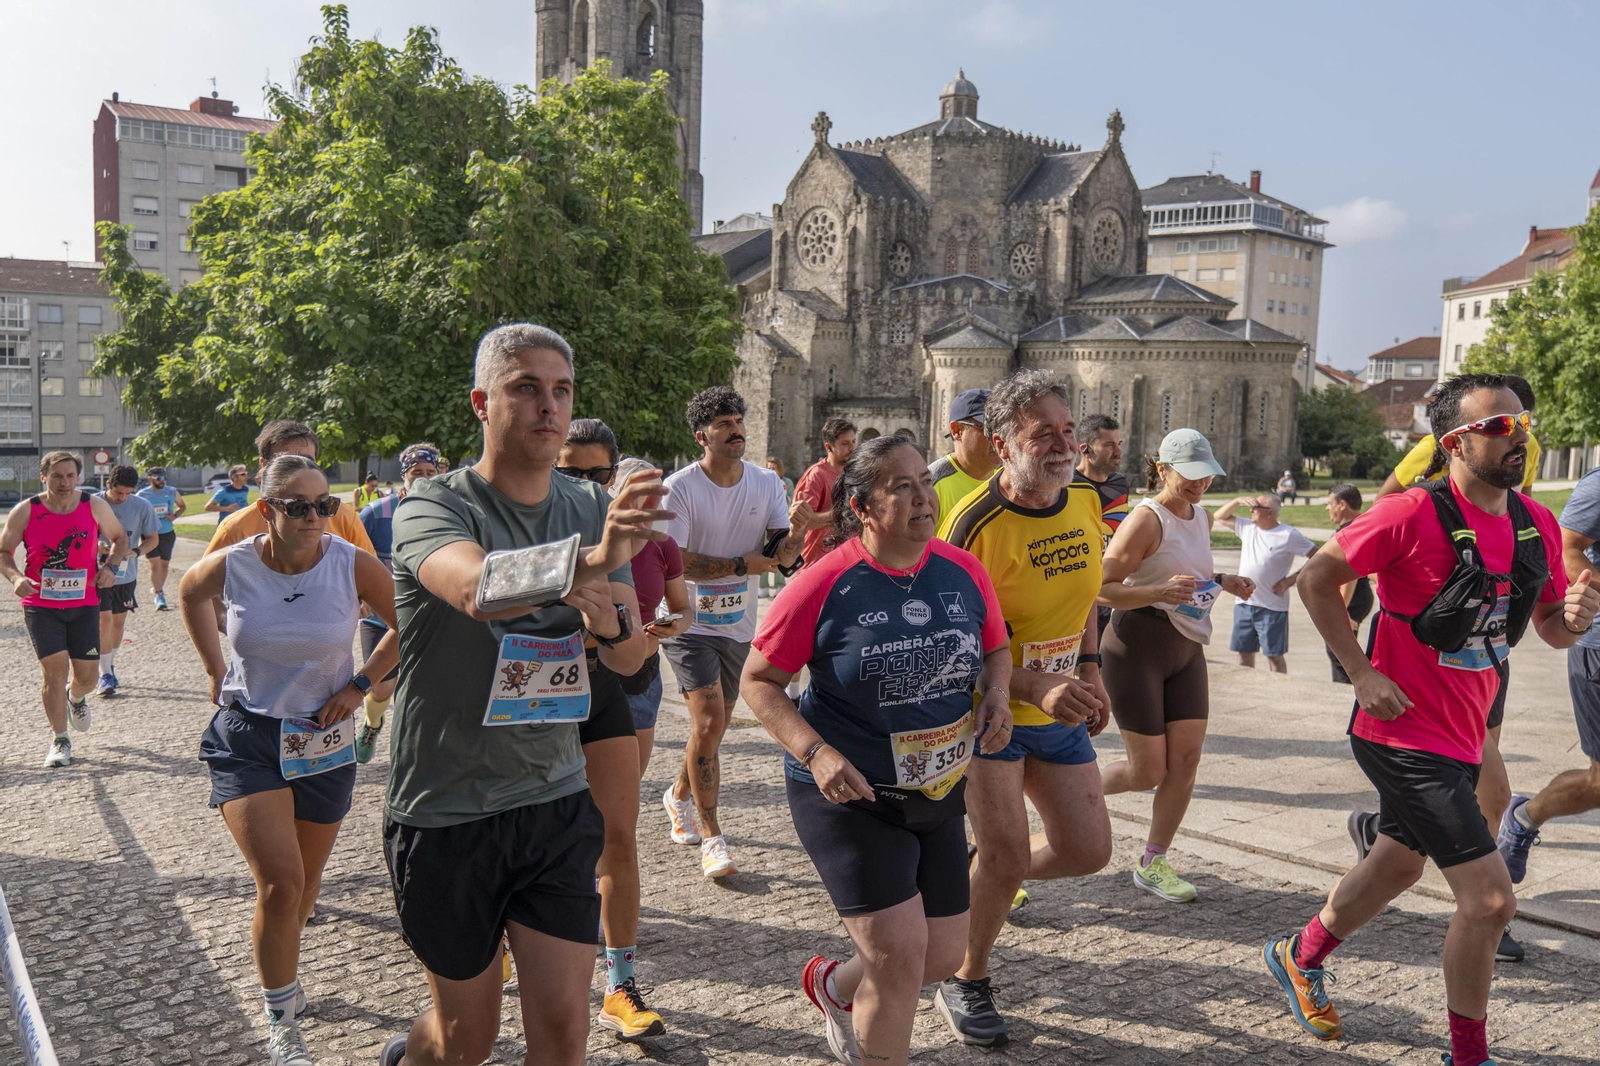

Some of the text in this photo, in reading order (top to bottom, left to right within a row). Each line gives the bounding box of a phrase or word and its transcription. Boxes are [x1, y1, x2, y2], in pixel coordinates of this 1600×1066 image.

[1027, 528, 1084, 551] ximnasio
[1044, 560, 1087, 581] fitness
[61, 579, 79, 587] 116
[720, 595, 742, 608] 134
[947, 603, 963, 614] AXA
[511, 638, 518, 647] II
[520, 639, 564, 650] CARREIRA
[861, 636, 934, 657] CARRERA
[1037, 641, 1065, 650] CARREIRA
[1057, 644, 1073, 653] PULPO
[537, 650, 551, 659] DO
[1052, 652, 1075, 672] 361
[549, 663, 579, 686] 68
[322, 728, 341, 748] 95
[906, 729, 946, 743] CARREIRA
[923, 732, 958, 748] DO PULPO
[935, 741, 966, 771] 330
